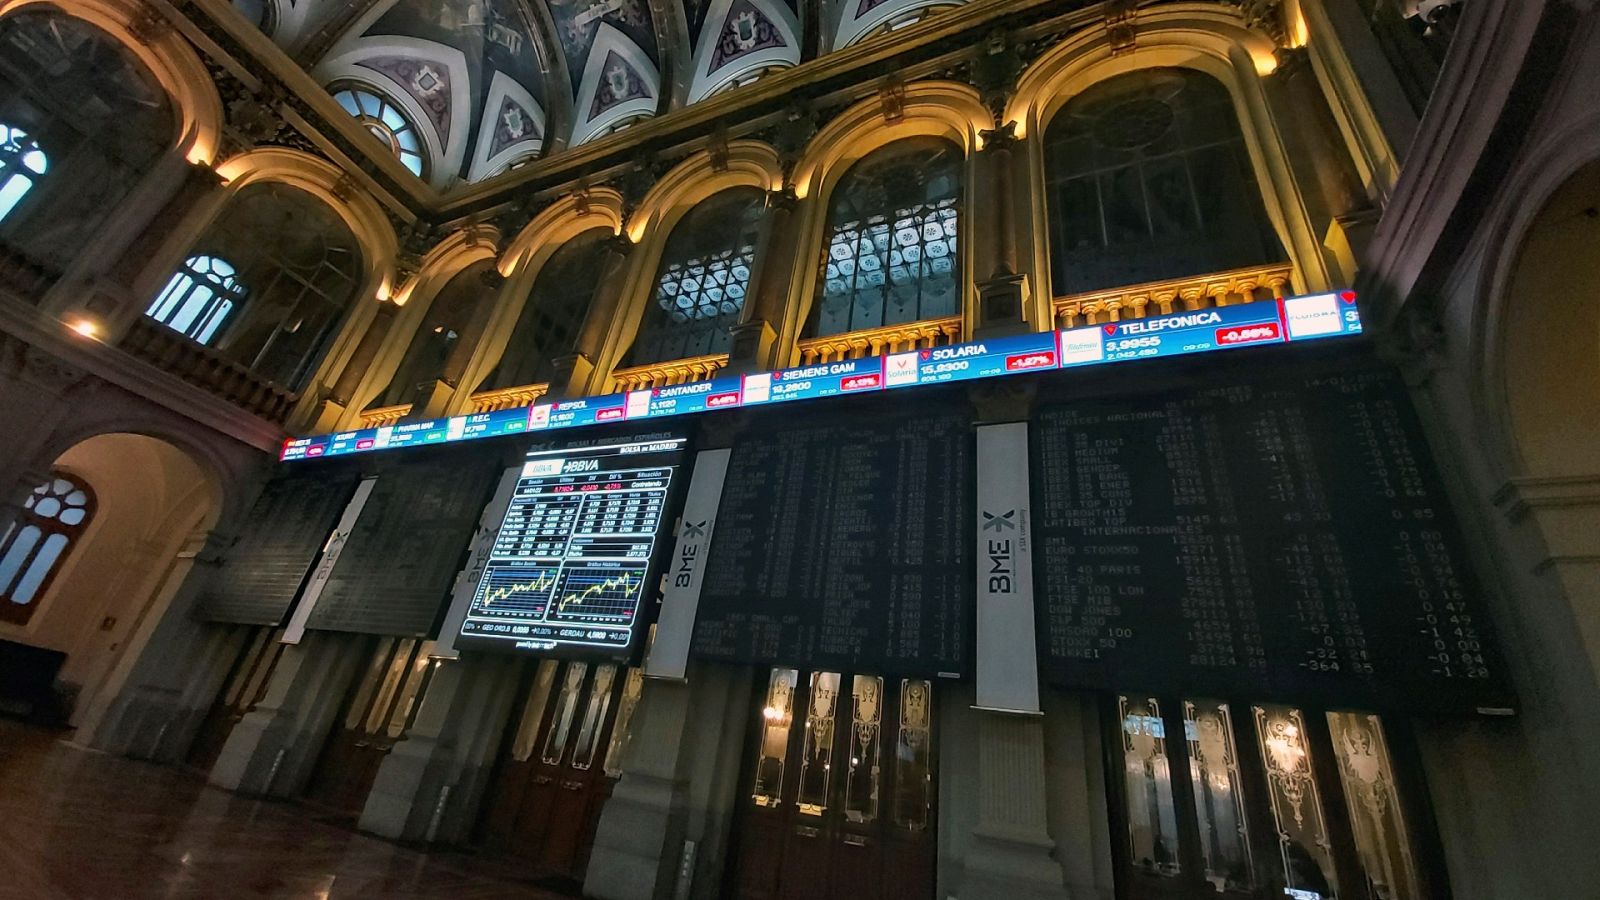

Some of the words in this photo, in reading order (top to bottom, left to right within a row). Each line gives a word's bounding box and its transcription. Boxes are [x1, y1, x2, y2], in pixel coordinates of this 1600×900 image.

[1119, 312, 1222, 335] TELEFONICA
[933, 345, 987, 361] SOLARIA
[783, 367, 829, 381] SIEMENS
[831, 362, 855, 374] GAM
[660, 383, 713, 398] SANTANDER
[559, 401, 588, 411] REPSOL
[1107, 409, 1182, 422] NACIONALES
[620, 445, 641, 454] BOLSA
[649, 442, 678, 452] MADRID
[569, 460, 598, 472] BBVA
[631, 480, 662, 488] Contratando
[1044, 517, 1097, 528] LATIBEX
[1083, 524, 1204, 536] INTERNACIONALES
[675, 544, 697, 588] BME
[988, 540, 1011, 594] BME
[1100, 565, 1141, 575] PARIS
[1109, 628, 1133, 638] 100
[1099, 638, 1117, 648] 50
[1051, 647, 1099, 659] NIKKEI
